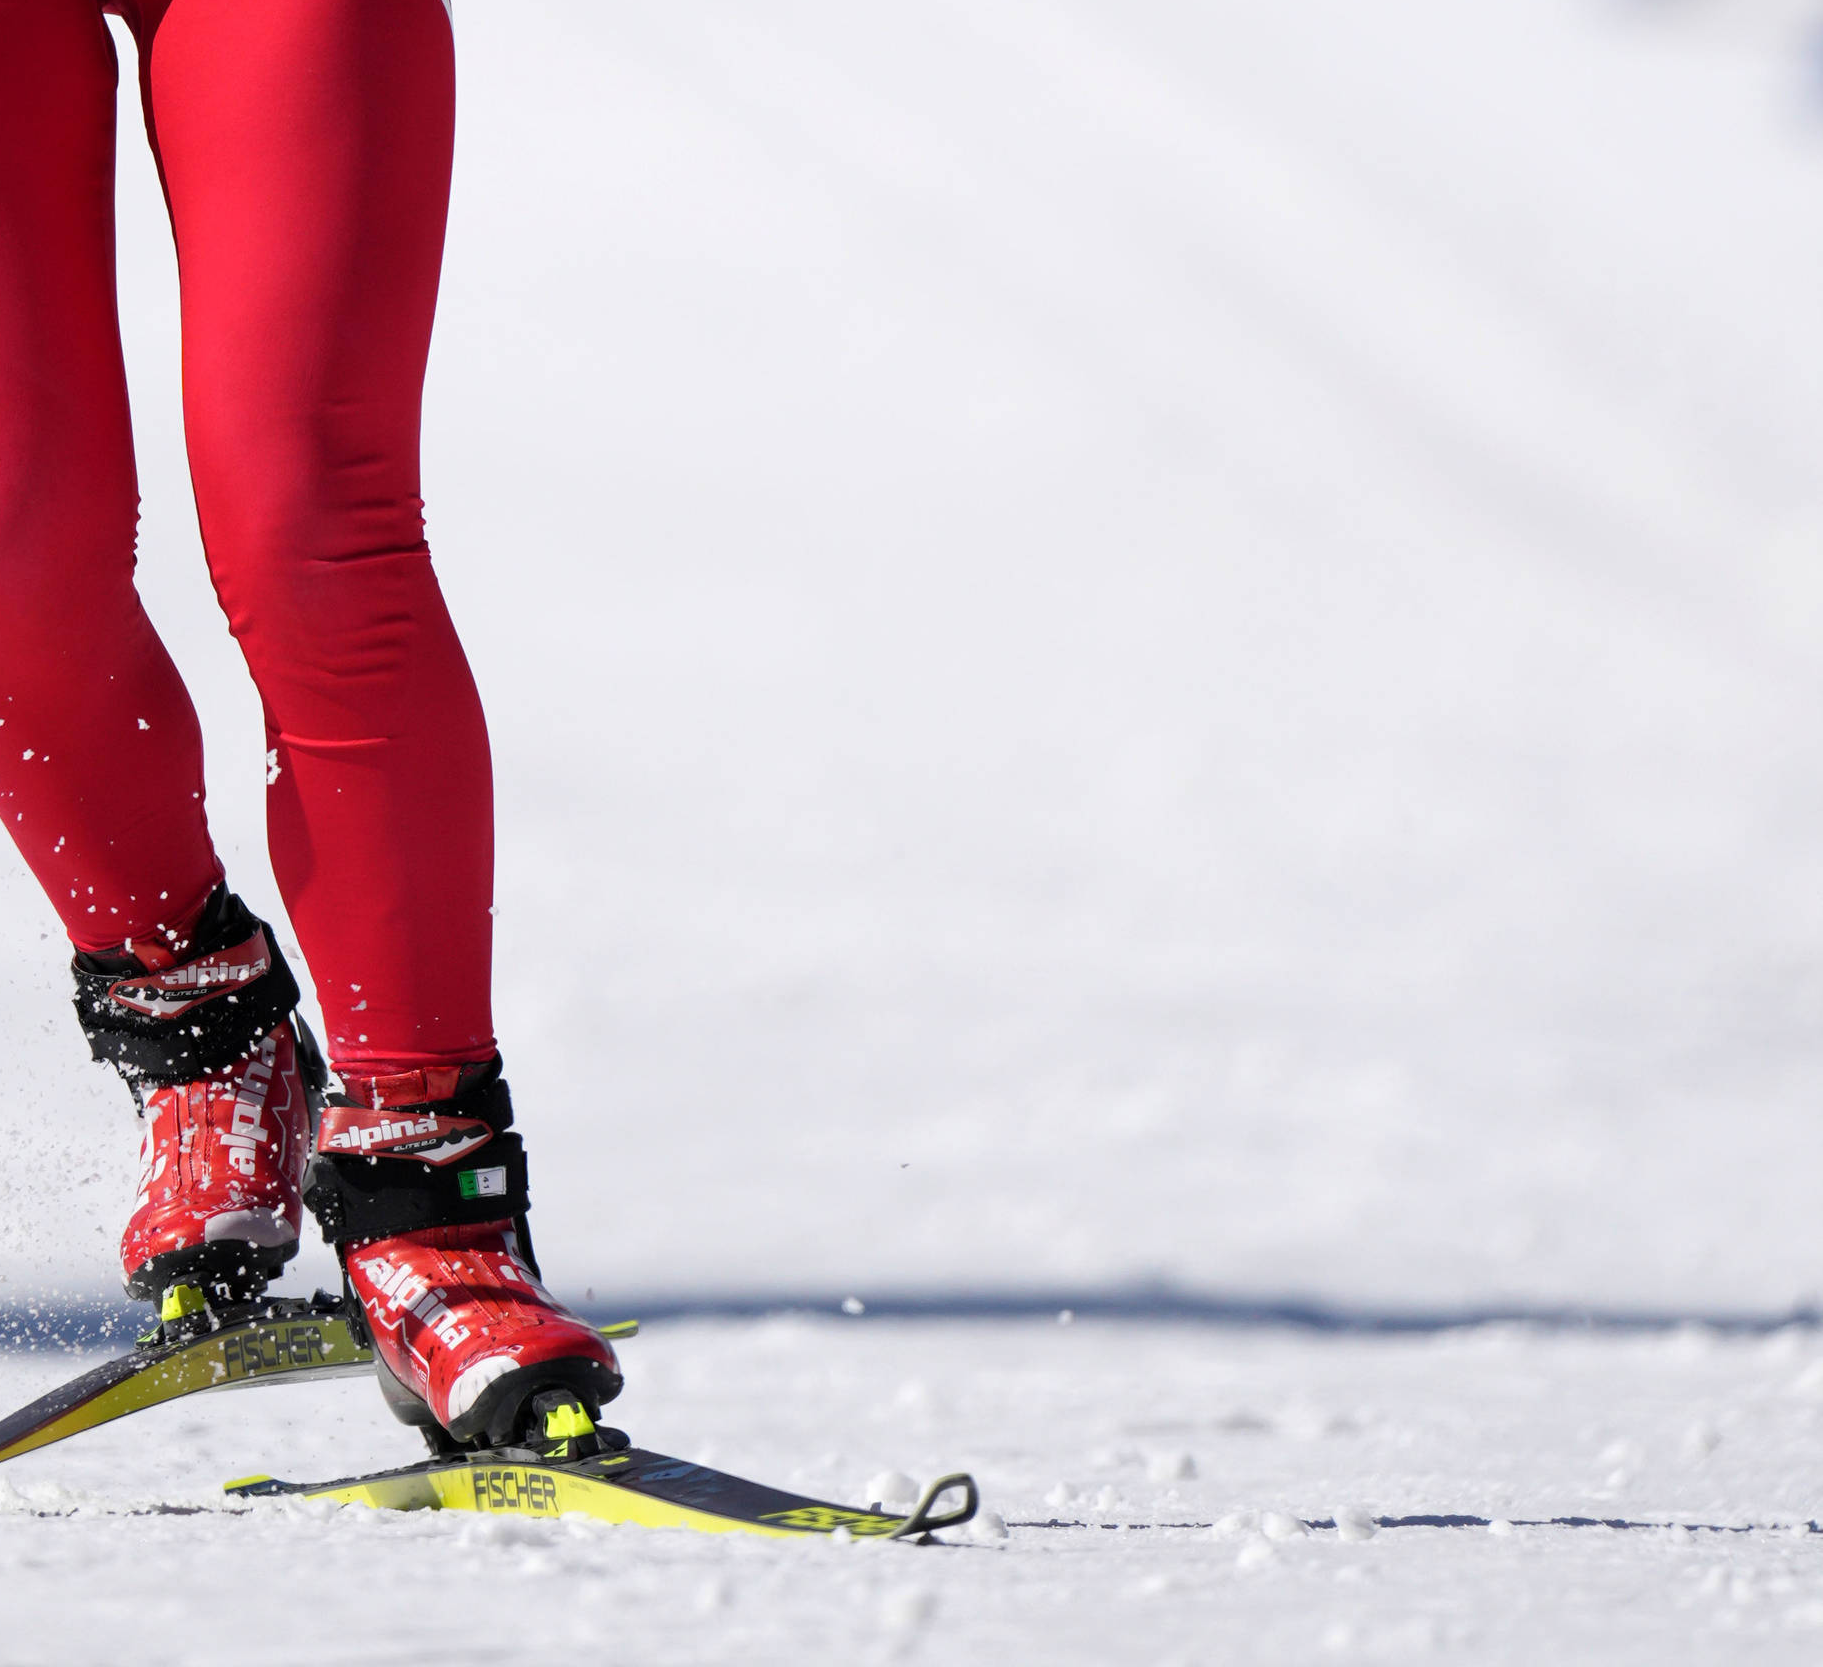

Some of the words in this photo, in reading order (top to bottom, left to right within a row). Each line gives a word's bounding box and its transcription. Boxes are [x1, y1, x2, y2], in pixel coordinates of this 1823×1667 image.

[164, 957, 267, 987] alpina
[220, 1036, 277, 1176] alpina
[328, 1117, 438, 1150] alpina
[393, 1141, 421, 1152] ELITE
[361, 1256, 471, 1351] alpina
[224, 1325, 325, 1378] FISCHER
[473, 1471, 559, 1513] FISCHER
